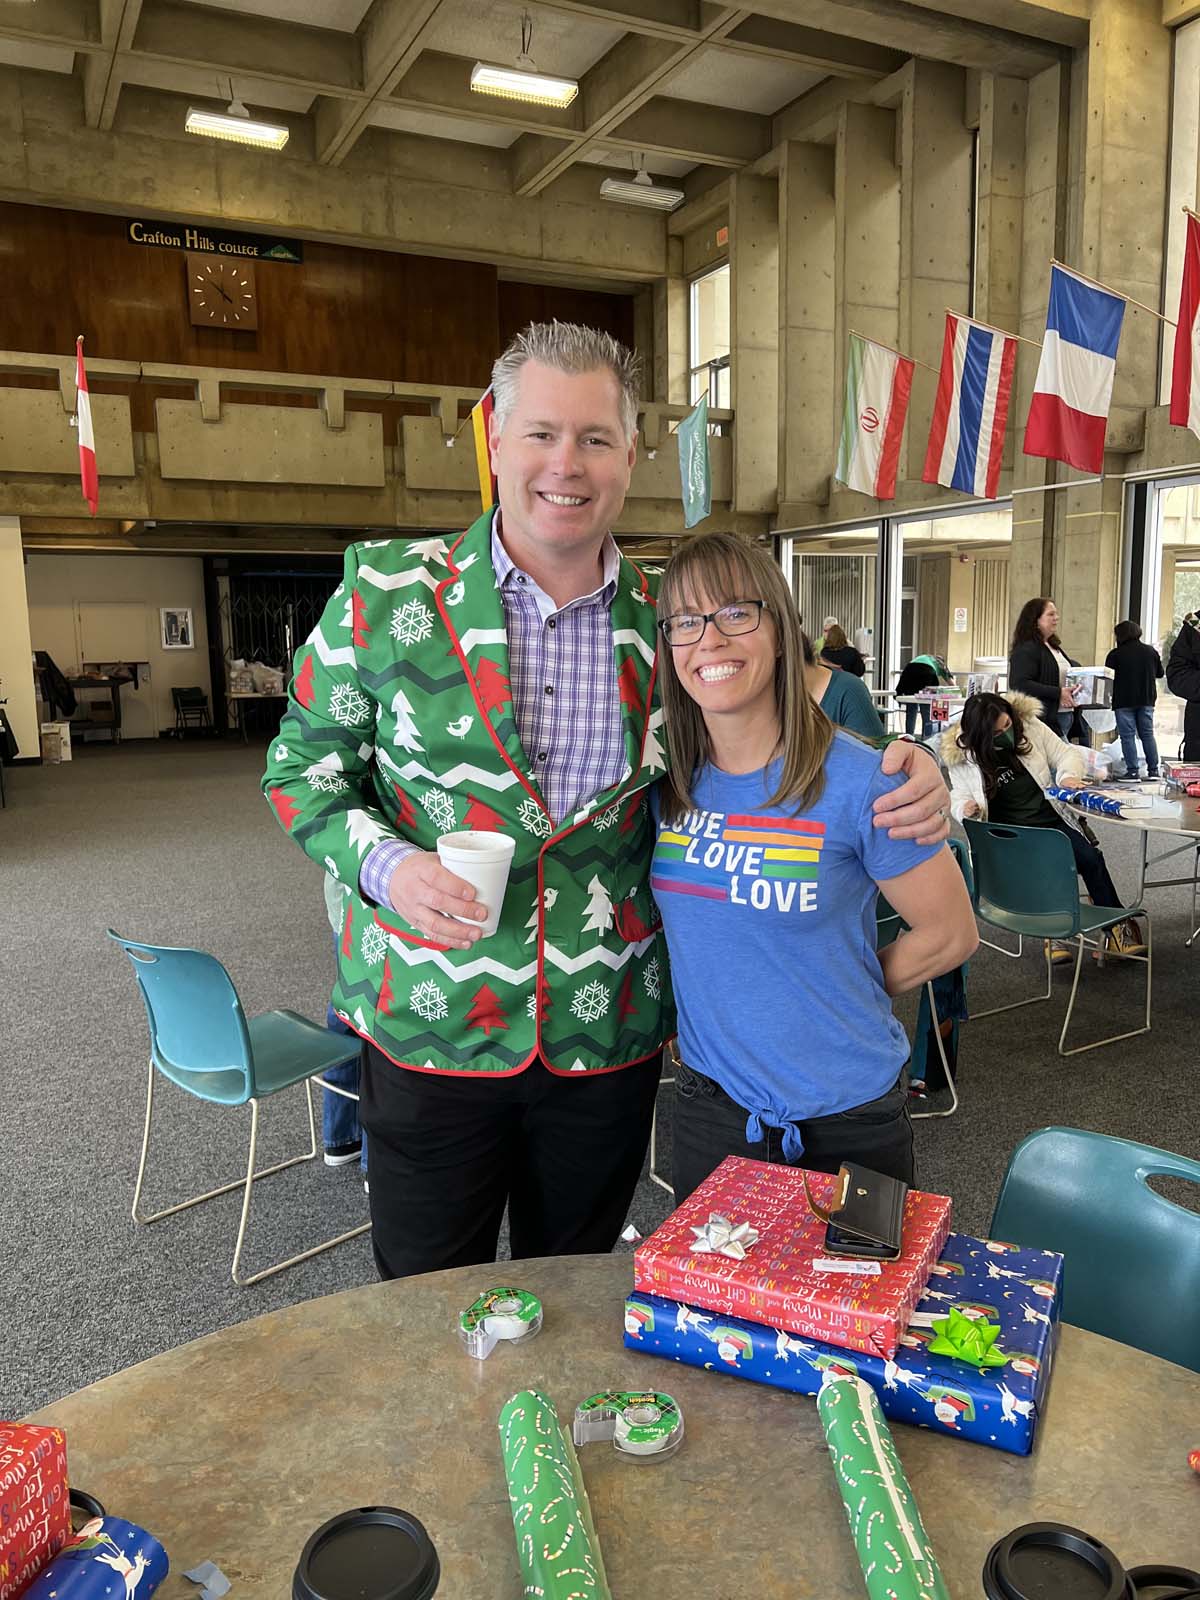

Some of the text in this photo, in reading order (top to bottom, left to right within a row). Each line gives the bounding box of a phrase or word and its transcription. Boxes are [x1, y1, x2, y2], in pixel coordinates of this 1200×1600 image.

[130, 222, 259, 256] Crafton Hills COLLEGE
[684, 837, 764, 876] LOVE
[730, 875, 818, 913] LOVE
[783, 1297, 821, 1321] Merry
